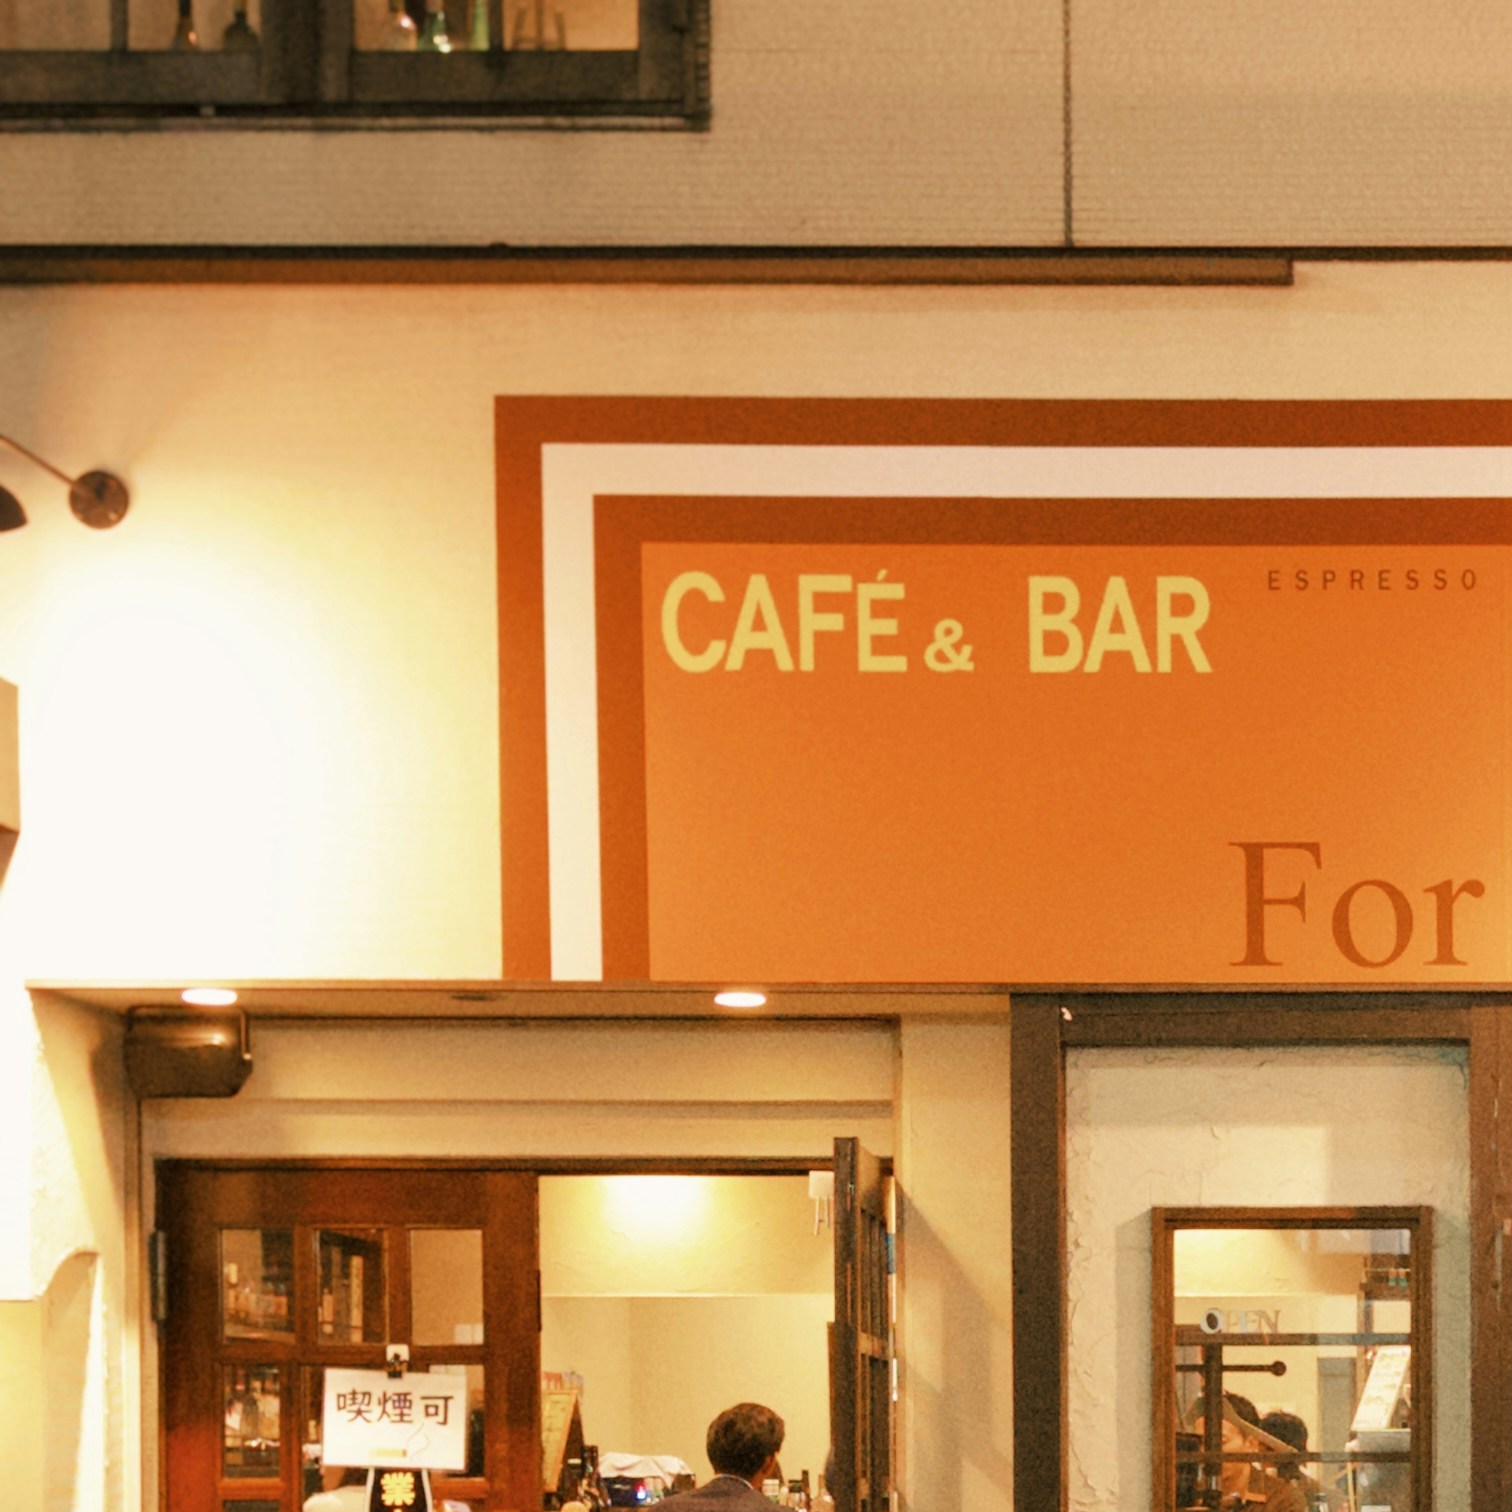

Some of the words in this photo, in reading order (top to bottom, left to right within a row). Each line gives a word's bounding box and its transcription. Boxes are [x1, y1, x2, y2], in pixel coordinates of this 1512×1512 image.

[1267, 567, 1478, 593] ESPRESSO
[661, 569, 909, 674] CAFÉ
[924, 619, 975, 674] &
[1029, 576, 1213, 674] BAR
[336, 1388, 455, 1427] 喫煙可
